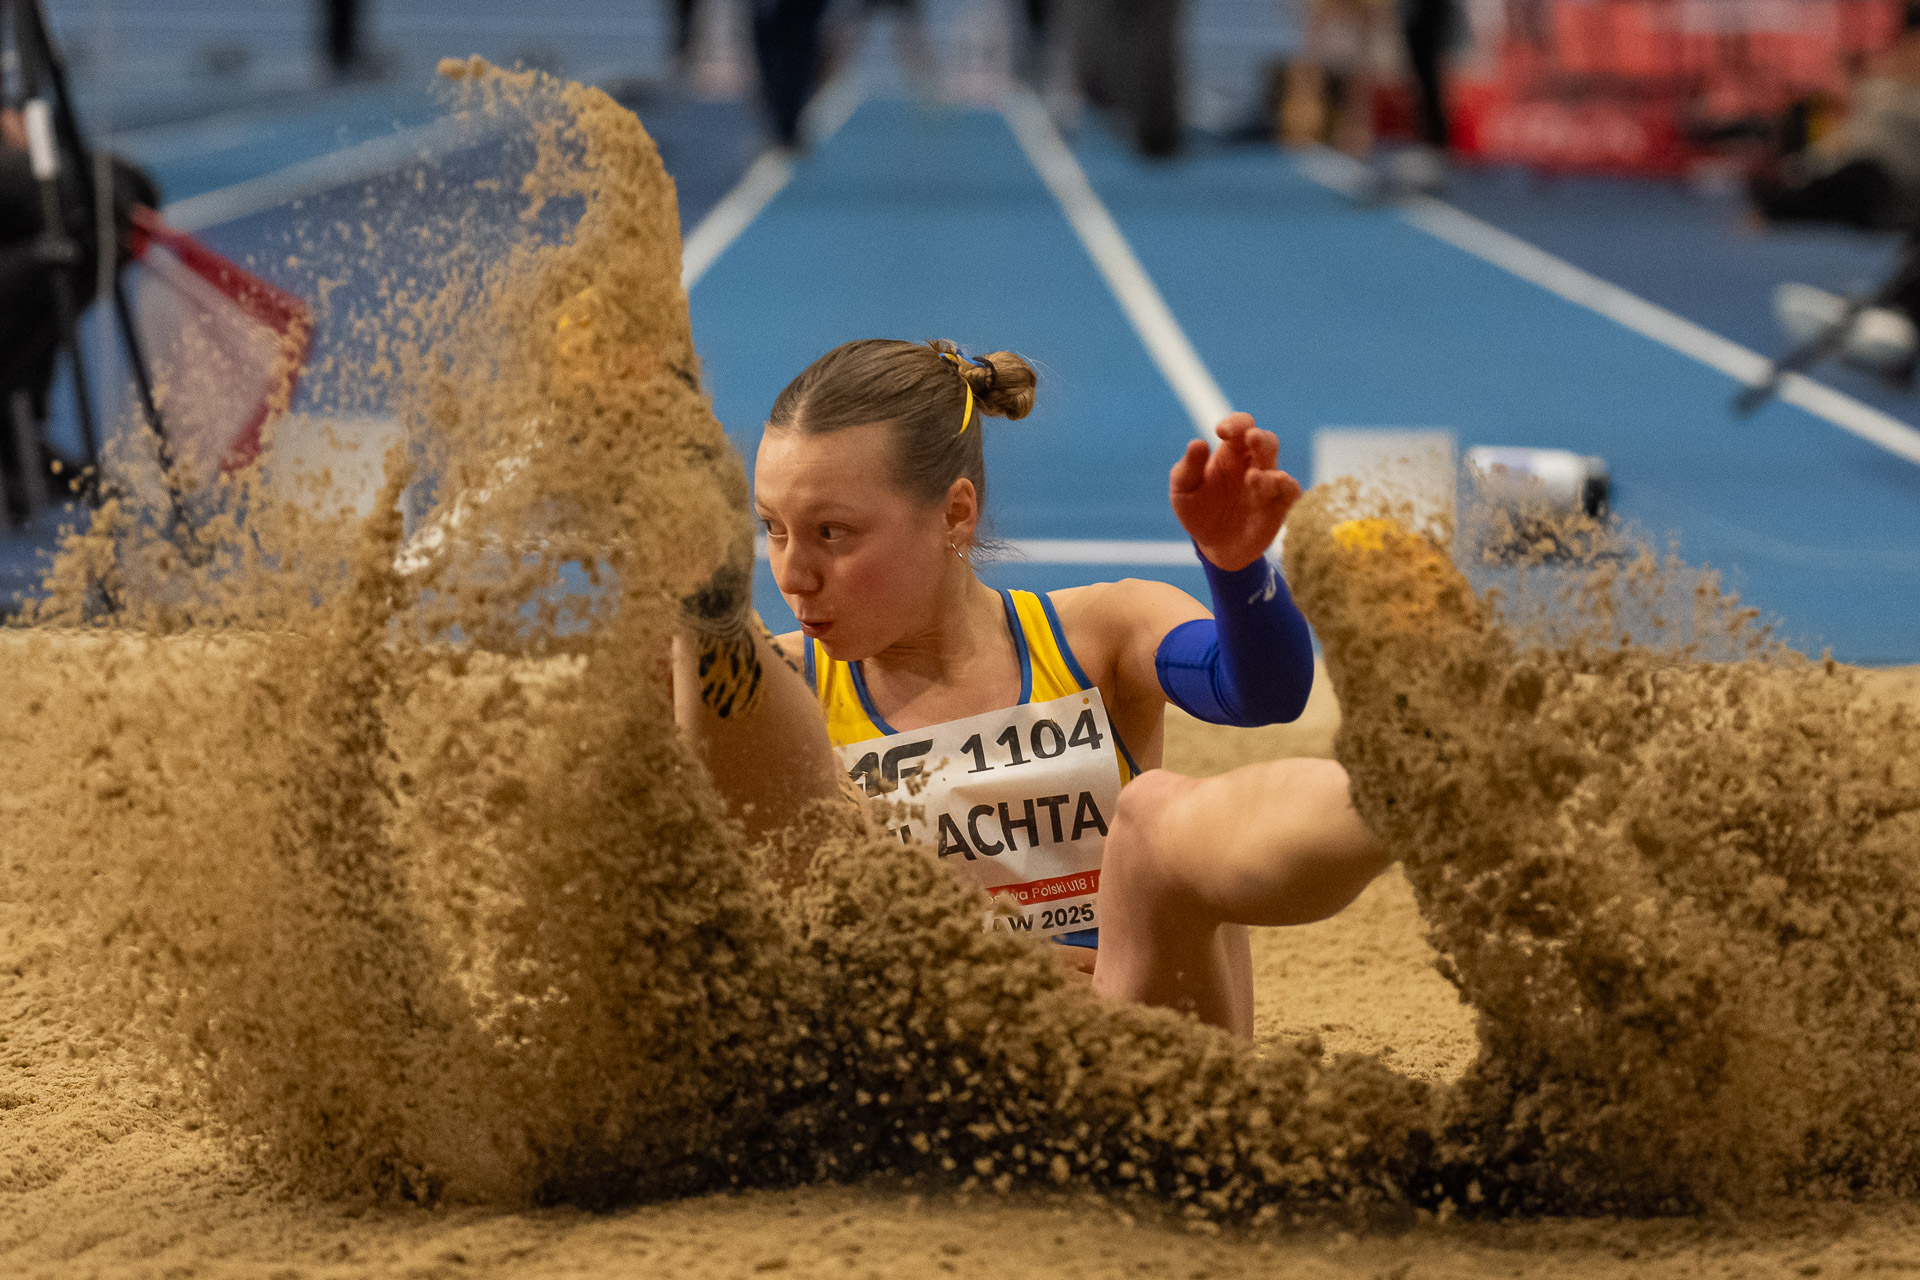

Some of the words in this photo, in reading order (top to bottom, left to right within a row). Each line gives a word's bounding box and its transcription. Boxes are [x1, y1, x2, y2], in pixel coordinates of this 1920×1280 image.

[960, 708, 1104, 774] 1104
[888, 791, 1109, 861] ACHTA
[1031, 881, 1067, 899] Polski
[1067, 878, 1088, 893] U18
[1041, 903, 1095, 930] 2025
